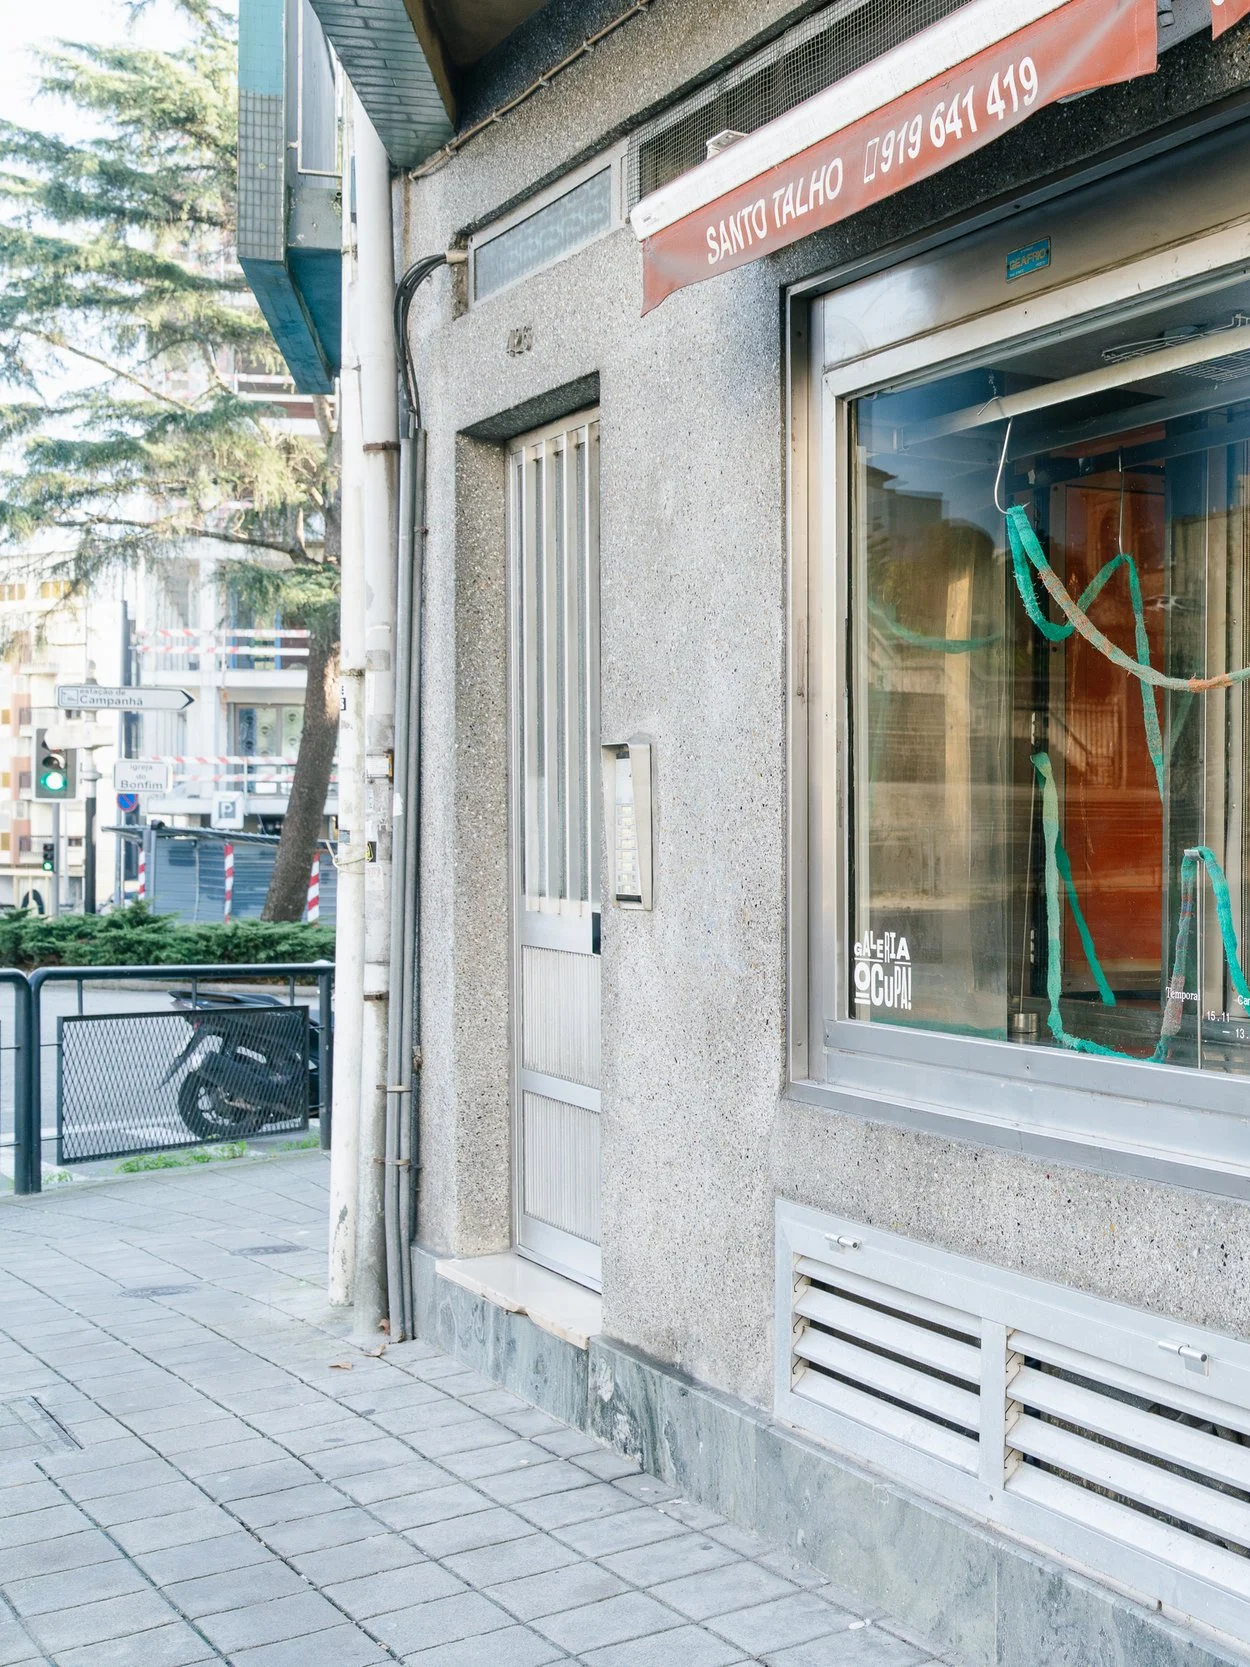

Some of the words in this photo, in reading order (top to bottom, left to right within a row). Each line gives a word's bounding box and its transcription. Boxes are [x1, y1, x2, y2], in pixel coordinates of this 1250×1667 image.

[706, 201, 768, 265] SANTO
[772, 157, 844, 228] TALHO
[880, 113, 922, 174] 919
[929, 85, 978, 149] 641
[986, 56, 1039, 121] 419
[120, 780, 163, 789] Bonfim
[221, 802, 233, 818] P
[854, 930, 910, 963] GALERIA
[854, 962, 912, 1010] OCUPA!
[1207, 1010, 1230, 1023] 15.11
